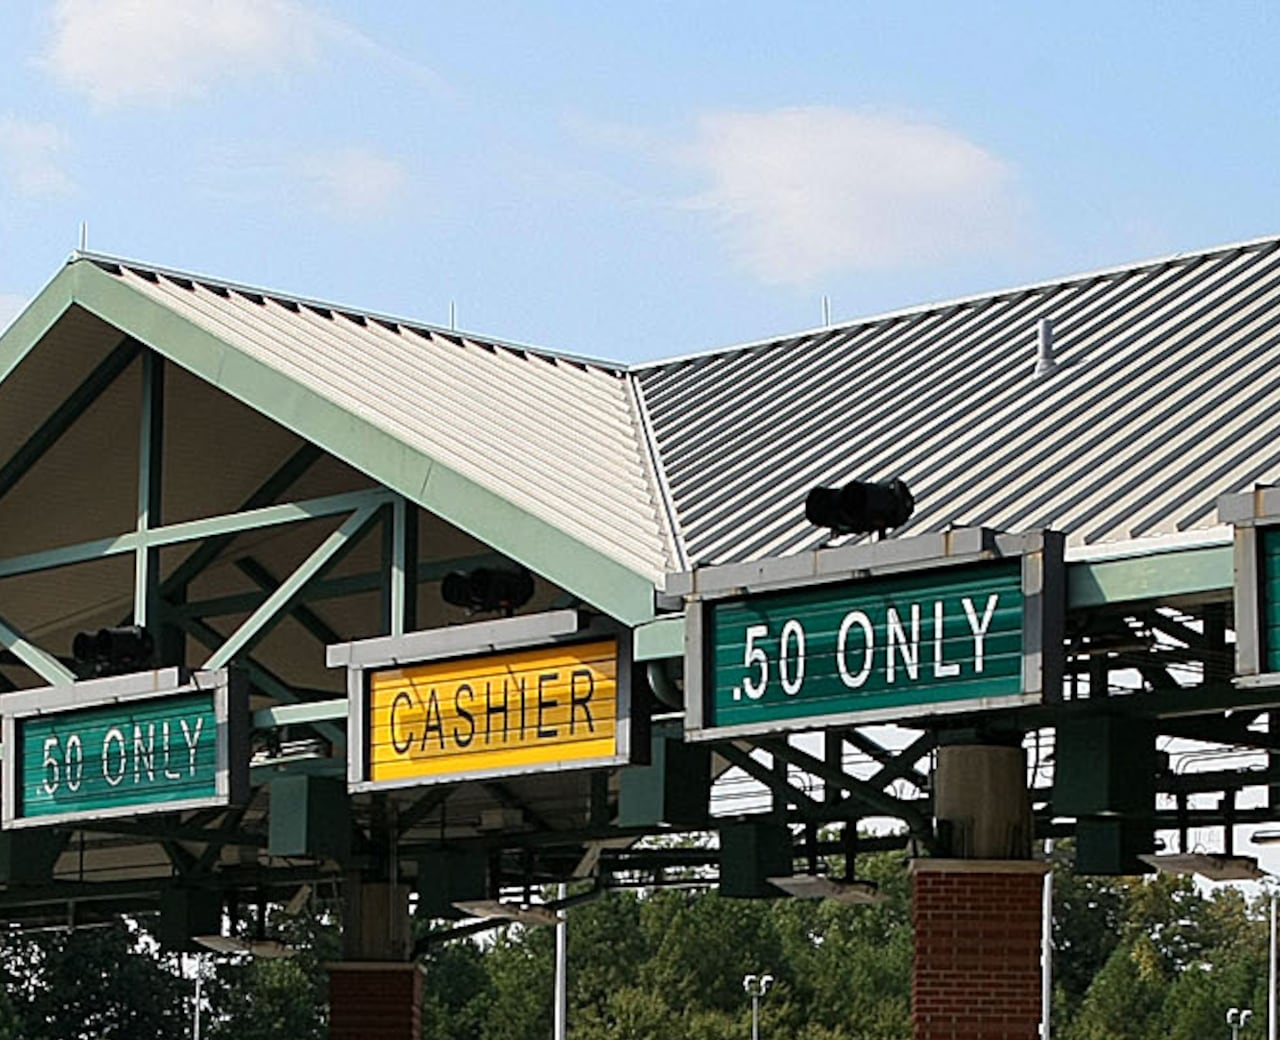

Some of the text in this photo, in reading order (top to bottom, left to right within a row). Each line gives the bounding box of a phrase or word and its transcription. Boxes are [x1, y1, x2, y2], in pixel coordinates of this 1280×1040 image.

[732, 594, 998, 701] .50 ONLY
[390, 668, 594, 754] CASHIER
[36, 718, 203, 795] .50 ONLY
